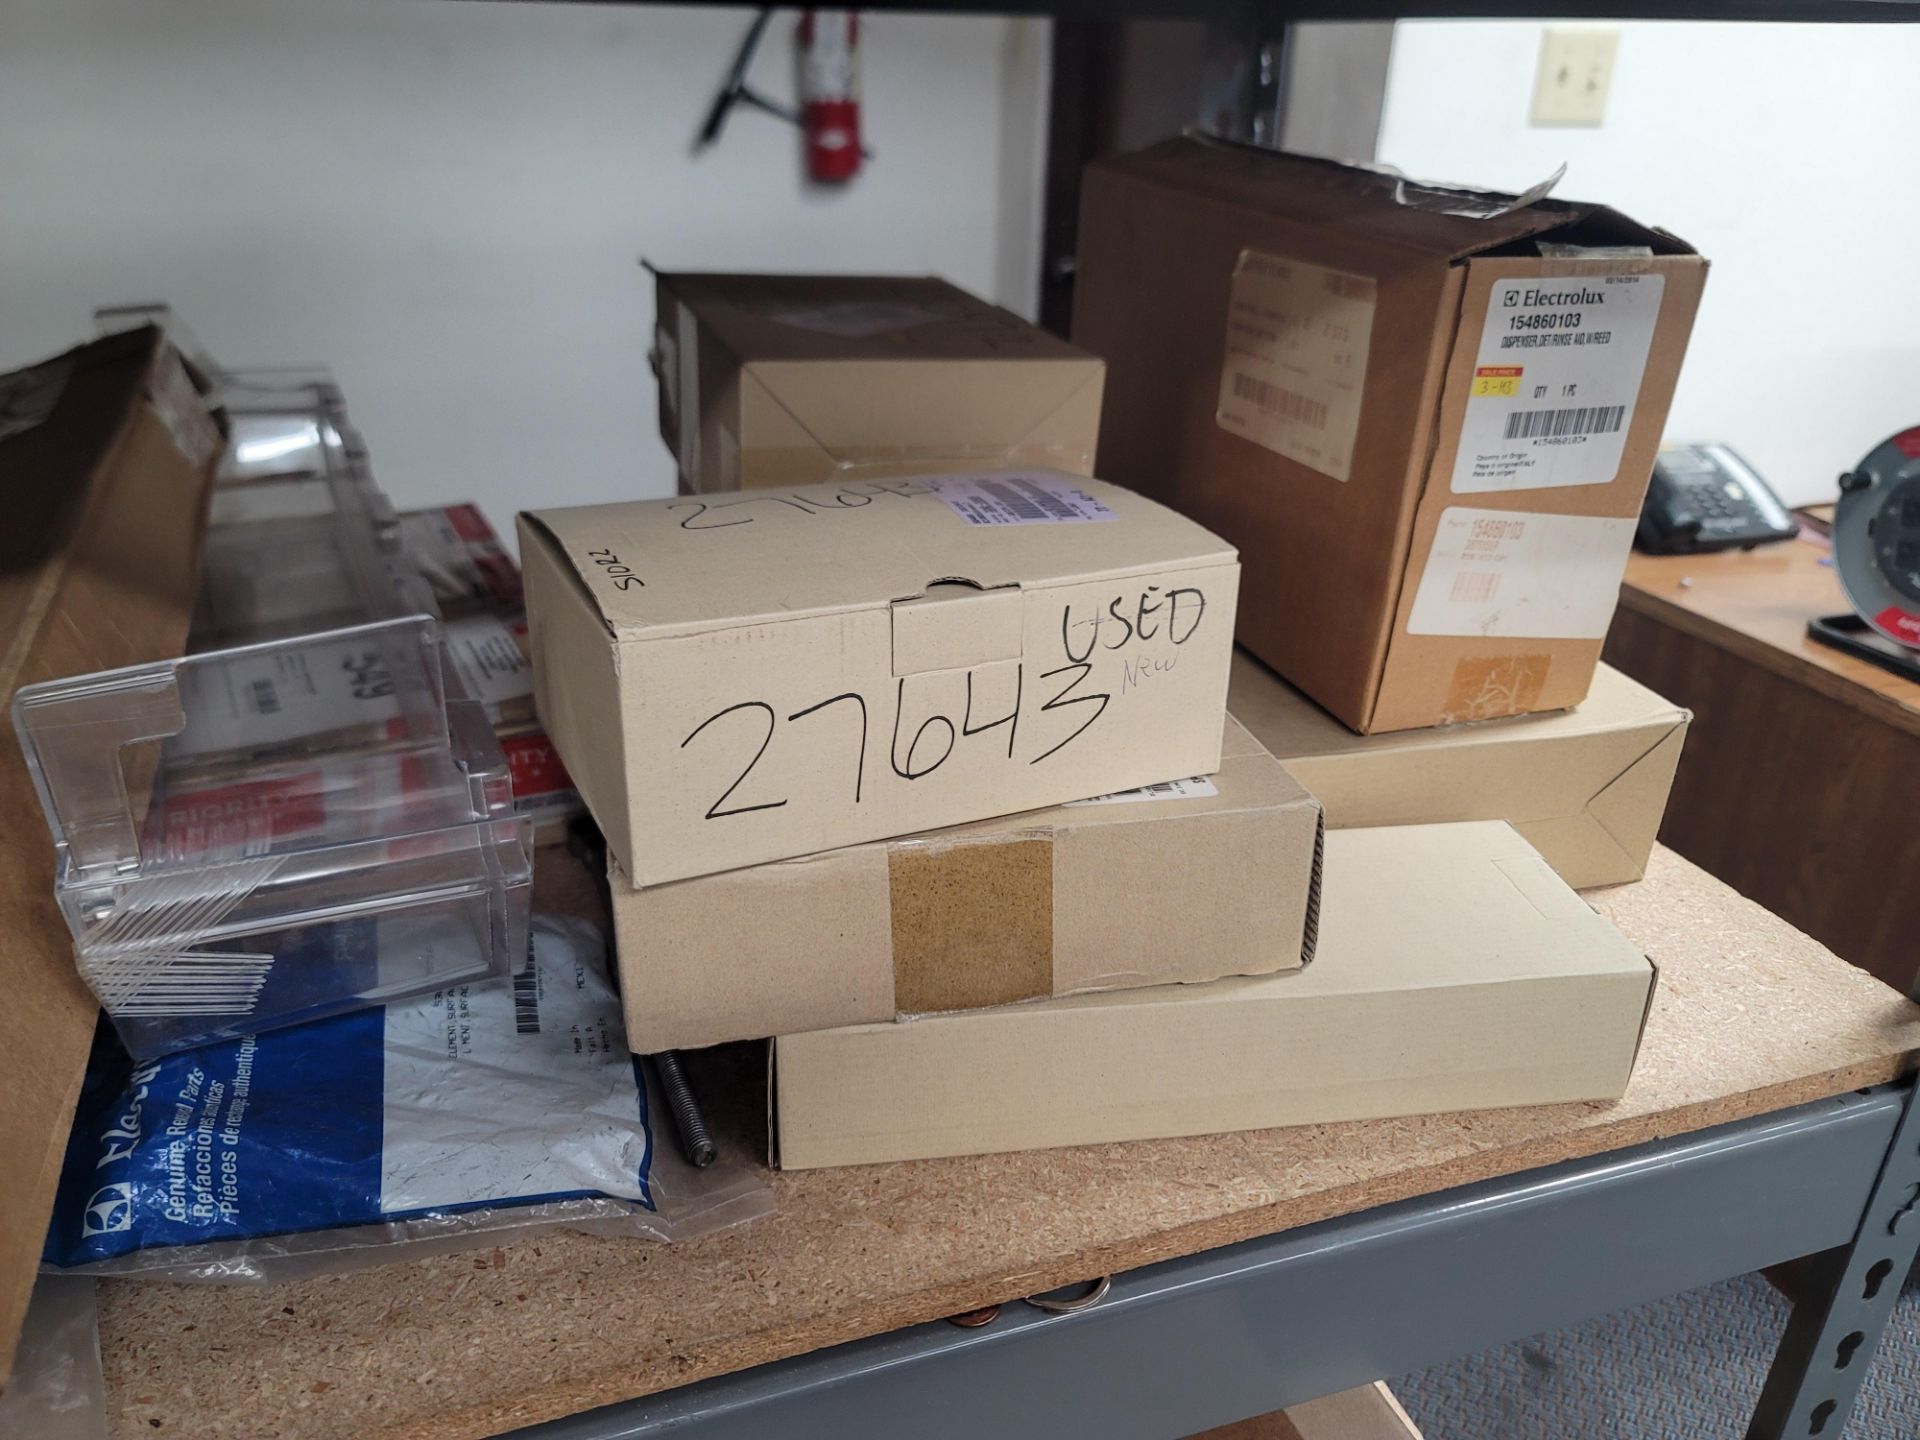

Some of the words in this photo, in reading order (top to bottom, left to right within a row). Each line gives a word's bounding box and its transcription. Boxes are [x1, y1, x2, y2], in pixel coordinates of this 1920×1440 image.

[1509, 313, 1581, 330] 154860103
[1523, 287, 1605, 307] Electrolux
[1534, 385, 1548, 398] QTY
[1062, 586, 1206, 663] USED
[1122, 653, 1179, 695] New
[681, 662, 1110, 820] 27643
[447, 988, 458, 1059] ELEMENT,SURFA
[234, 1033, 259, 1097] authentique
[164, 1140, 187, 1222] Genuine
[179, 1067, 205, 1102] Parts
[193, 1117, 215, 1217] Refacciones
[219, 1128, 240, 1145] de
[219, 1151, 240, 1214] Pièces
